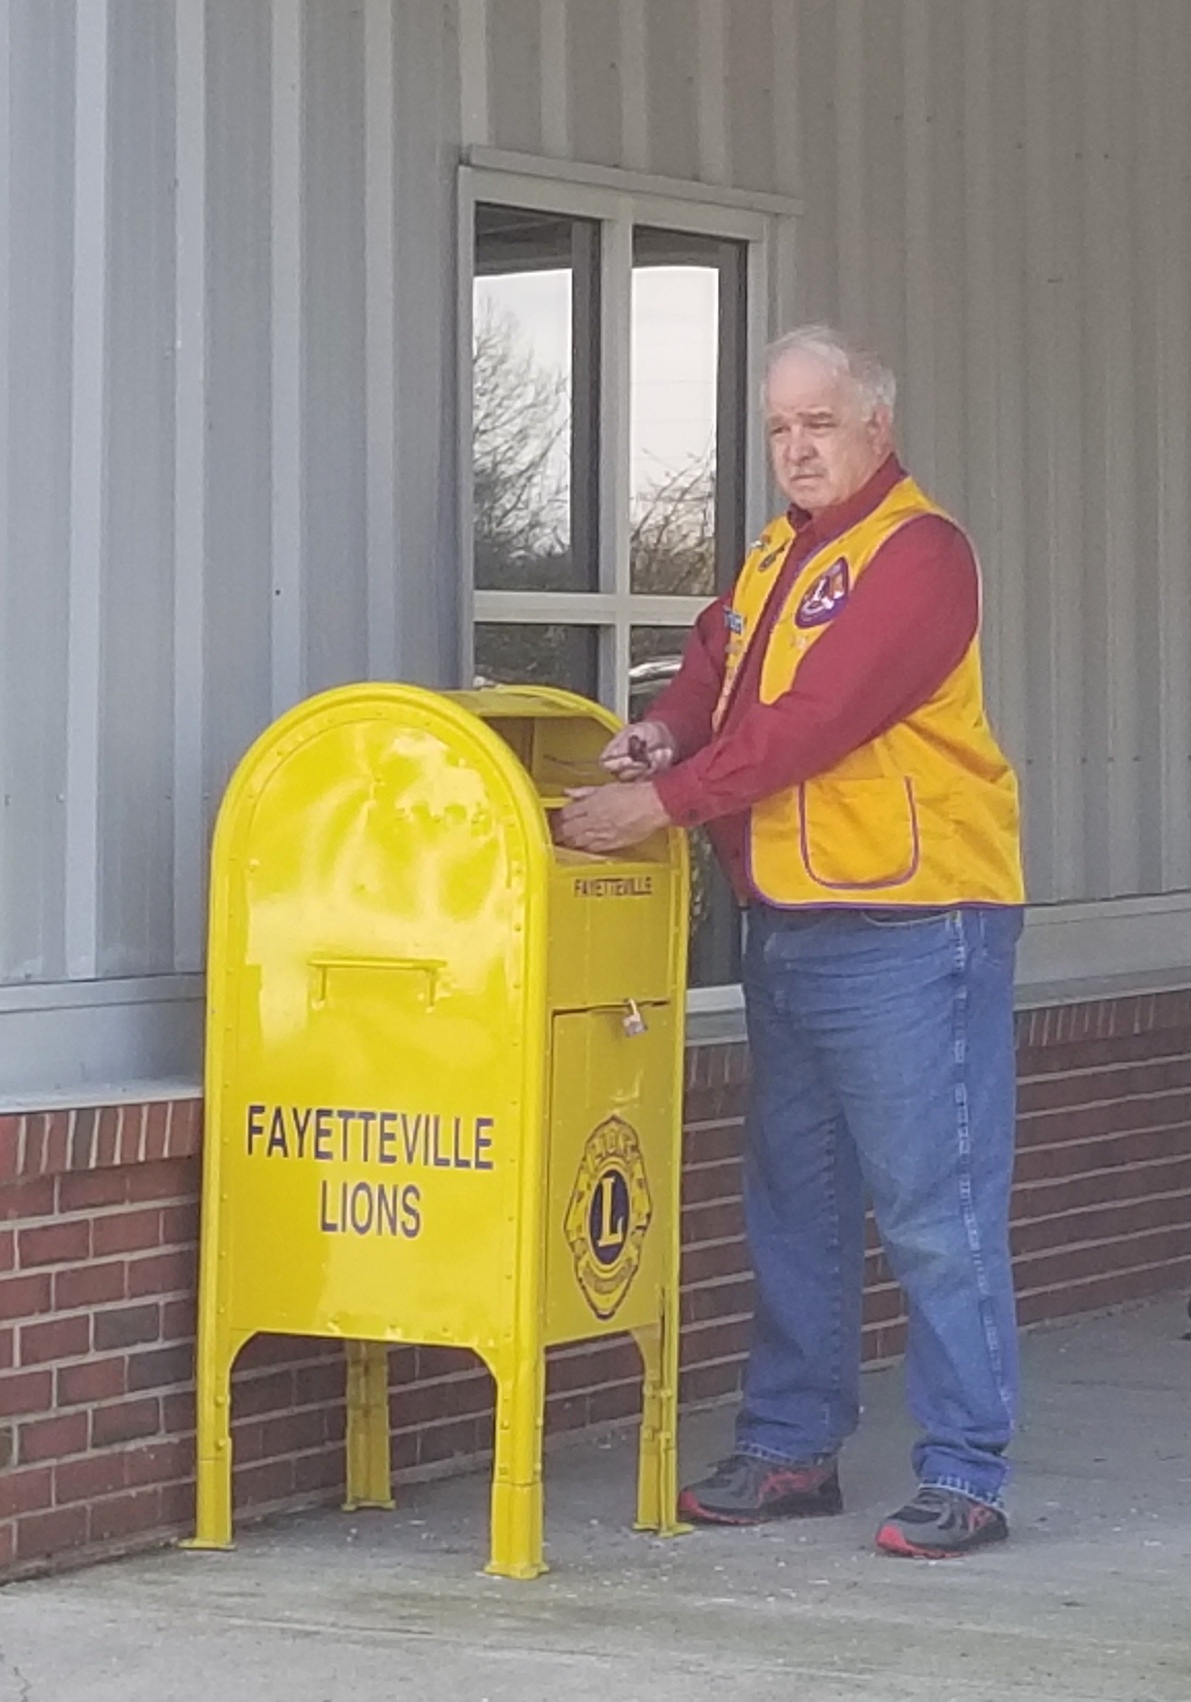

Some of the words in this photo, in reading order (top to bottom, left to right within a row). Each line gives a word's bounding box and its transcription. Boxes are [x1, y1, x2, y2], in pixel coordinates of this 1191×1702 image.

[574, 877, 651, 897] FAYETTEVILLE
[247, 1105, 494, 1169] FAYETTEVILLE
[321, 1180, 421, 1238] LIONS
[598, 1176, 624, 1247] L
